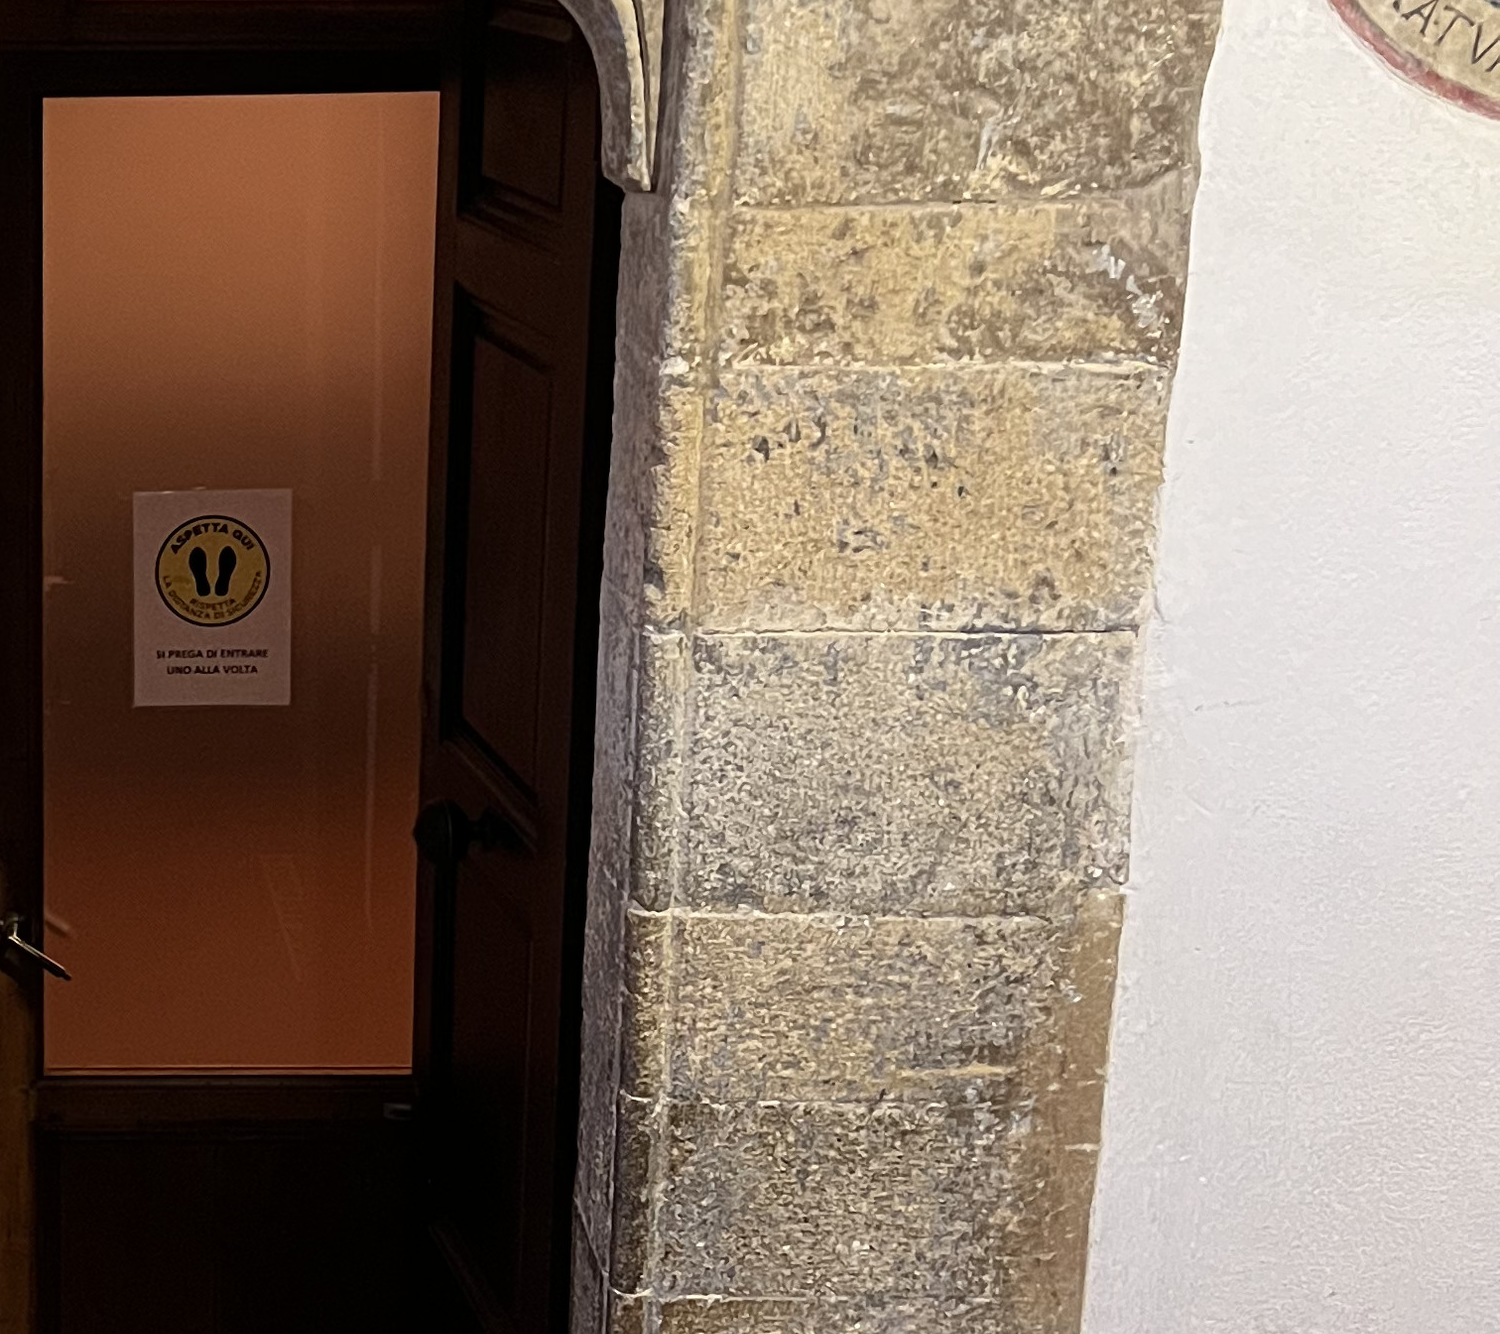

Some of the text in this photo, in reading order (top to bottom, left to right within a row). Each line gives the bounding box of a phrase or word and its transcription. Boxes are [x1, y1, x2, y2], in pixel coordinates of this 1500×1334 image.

[170, 522, 255, 555] ASPETTA QUI
[163, 570, 262, 620] LA DISTANZA DI SICUREZZA
[189, 598, 236, 611] RISPETTA
[156, 648, 269, 659] SI PREGA DI ENTRARE
[167, 664, 258, 675] UNO ALLA VOLTA
